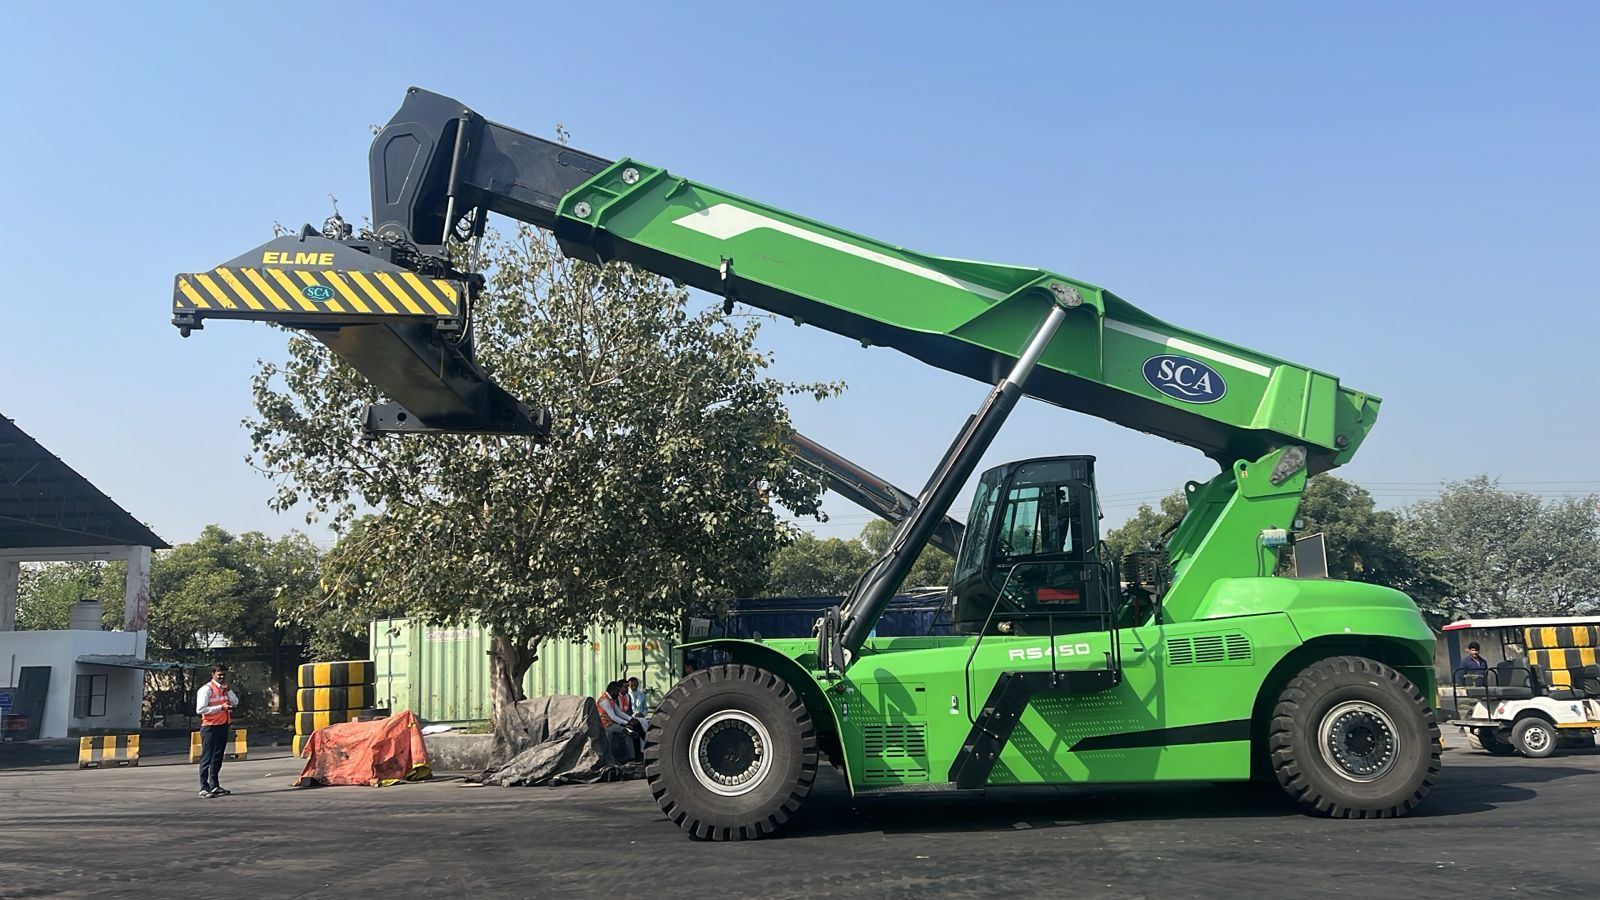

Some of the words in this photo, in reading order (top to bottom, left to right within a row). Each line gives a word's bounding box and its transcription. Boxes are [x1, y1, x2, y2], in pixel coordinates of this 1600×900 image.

[262, 252, 334, 265] ELME
[307, 289, 330, 298] SCA
[1157, 359, 1213, 394] SCA
[1008, 643, 1090, 661] RS450
